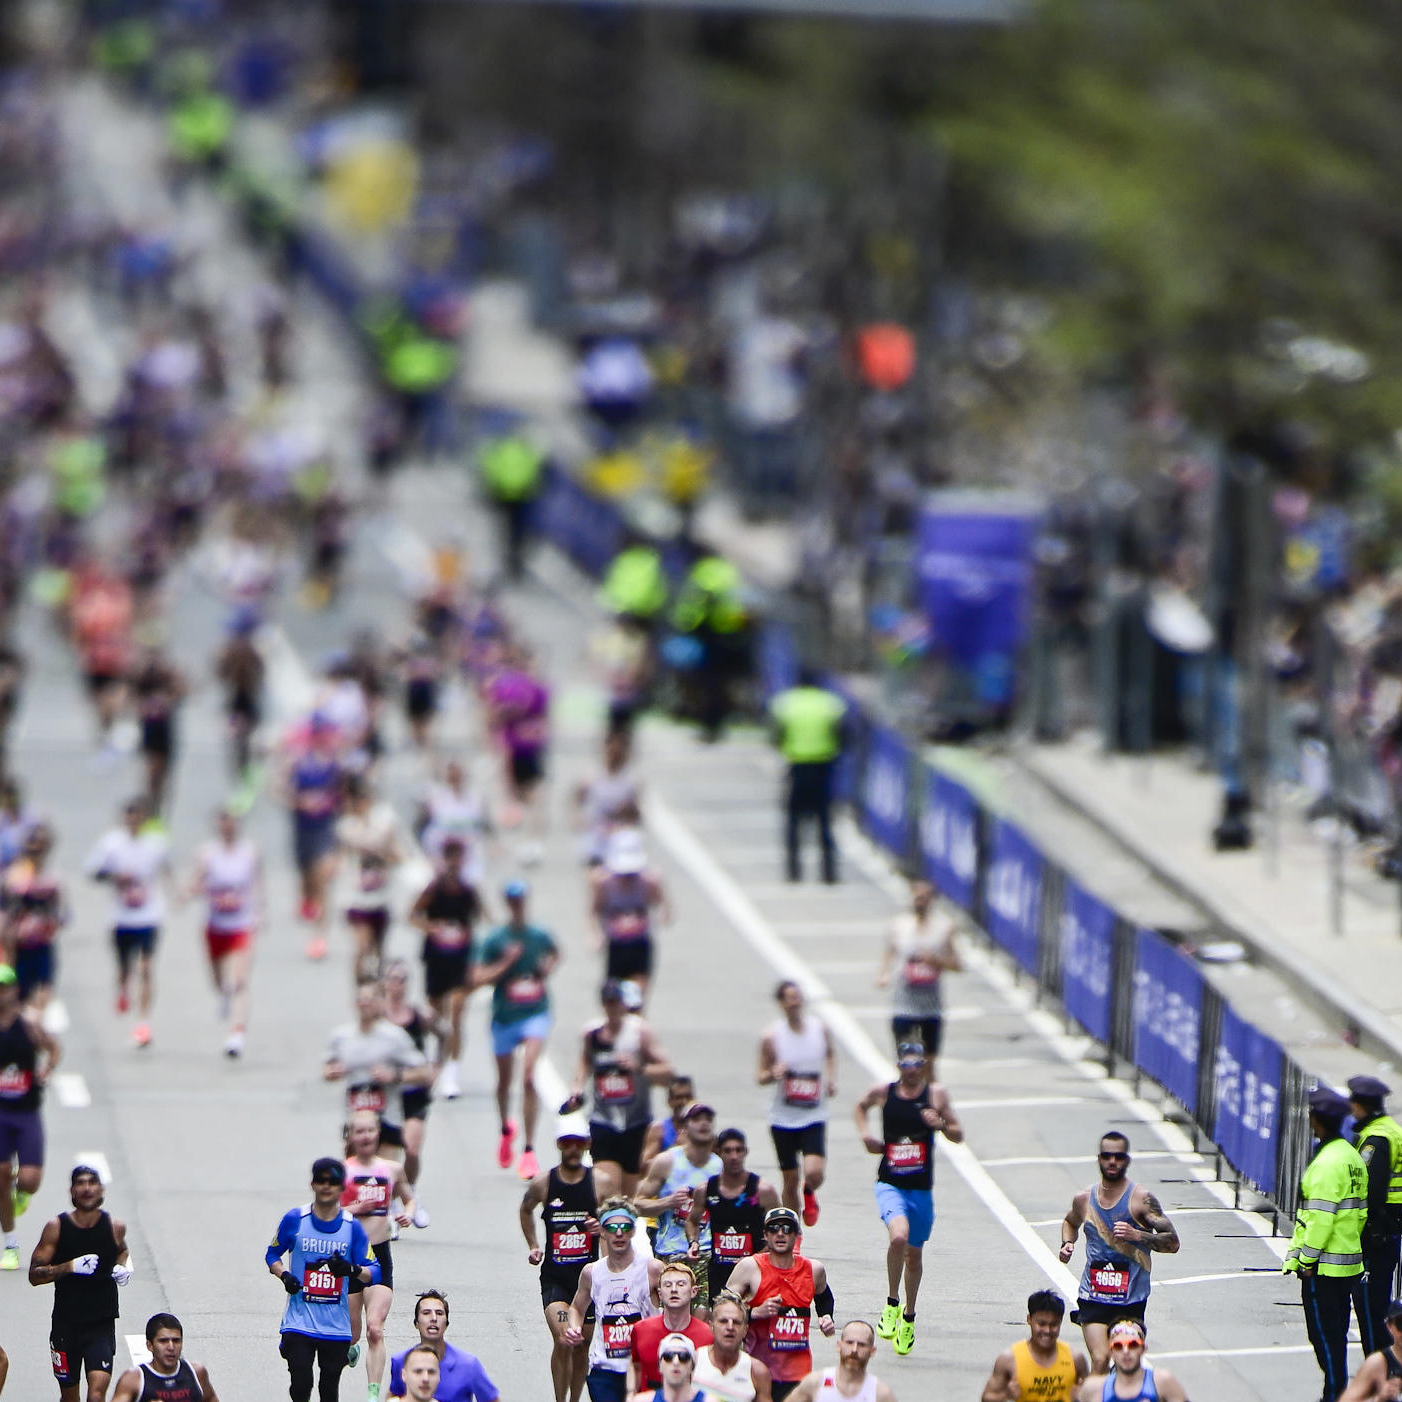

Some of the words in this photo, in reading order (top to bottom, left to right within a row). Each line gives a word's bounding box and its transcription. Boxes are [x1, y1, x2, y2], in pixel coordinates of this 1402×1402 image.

[301, 1237, 348, 1256] BRUINS
[559, 1233, 586, 1249] 2862
[719, 1235, 746, 1250] 2667
[309, 1271, 336, 1289] 3151
[775, 1317, 805, 1335] 4475
[1033, 1375, 1064, 1385] NAVY
